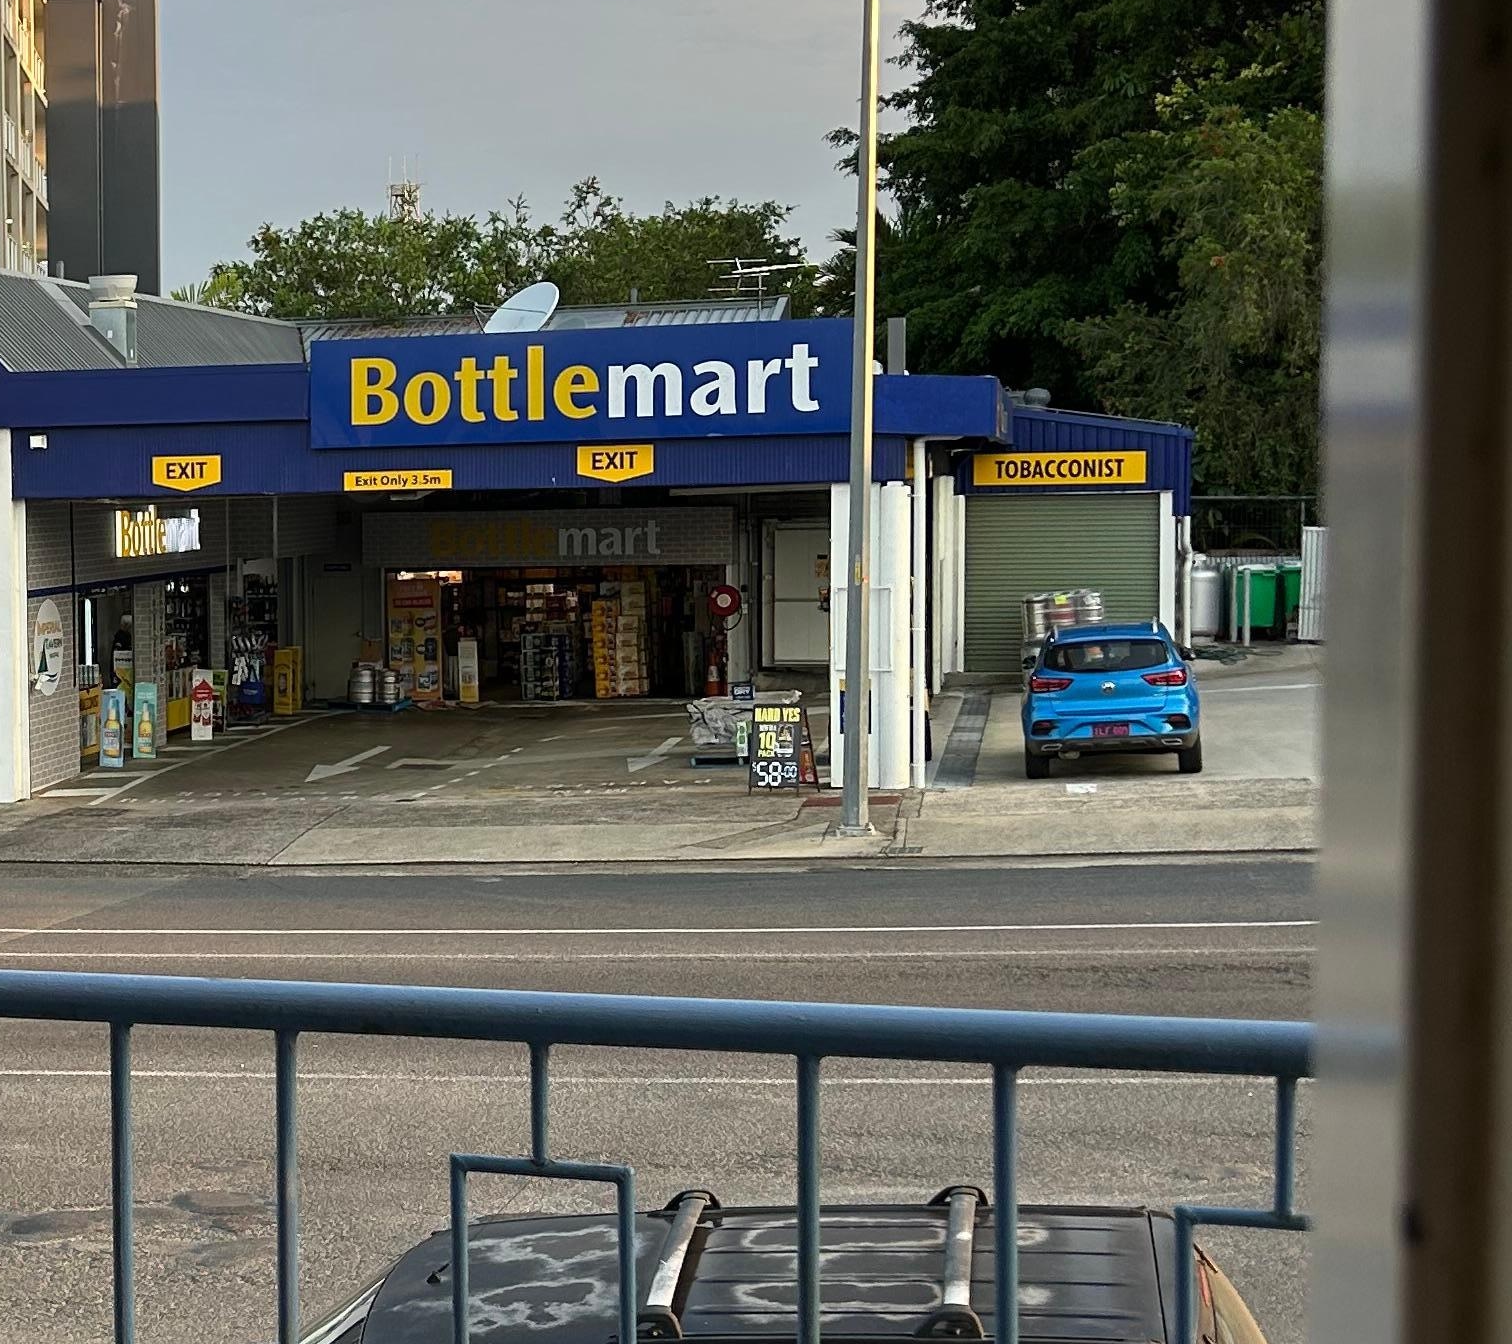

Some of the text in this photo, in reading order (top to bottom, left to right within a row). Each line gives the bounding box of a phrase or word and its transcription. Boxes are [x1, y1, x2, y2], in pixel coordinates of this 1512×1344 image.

[351, 343, 820, 426] Bottlemart
[166, 462, 207, 479] EXIT
[591, 451, 638, 471] EXIT
[995, 459, 1124, 479] TOBACCONIST
[355, 476, 377, 486] Exit
[381, 475, 408, 488] Only
[115, 504, 200, 558] Bottlemart
[782, 707, 801, 722] YES
[758, 731, 777, 750] 10
